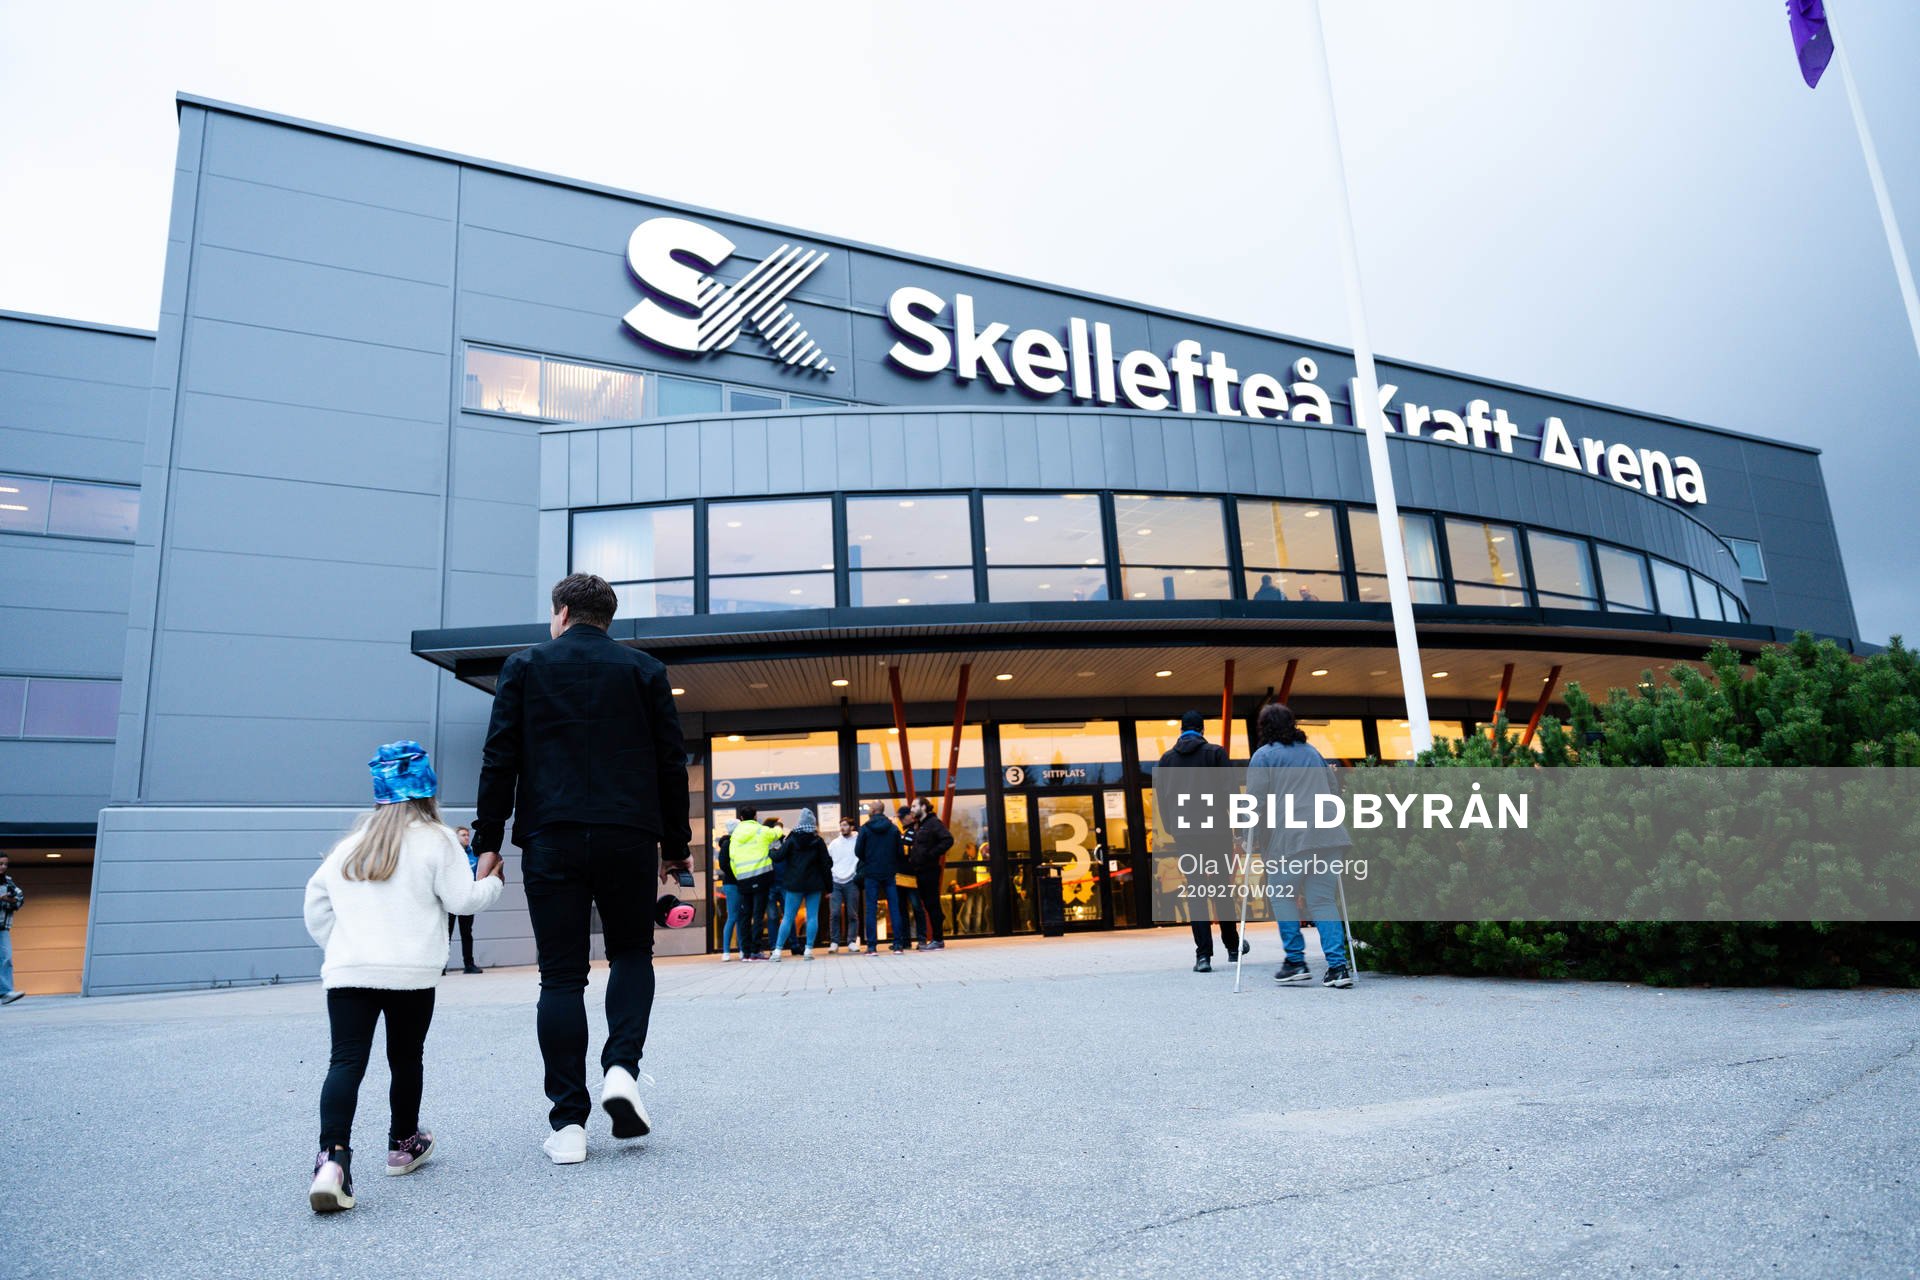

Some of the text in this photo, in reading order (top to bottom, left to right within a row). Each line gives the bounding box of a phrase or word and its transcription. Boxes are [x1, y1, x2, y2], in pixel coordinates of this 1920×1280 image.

[888, 286, 1707, 505] Skellefteå Kraft Arena
[754, 781, 800, 792] SITTPLATS
[1042, 768, 1086, 779] SITTPLATS
[1047, 812, 1091, 883] 3
